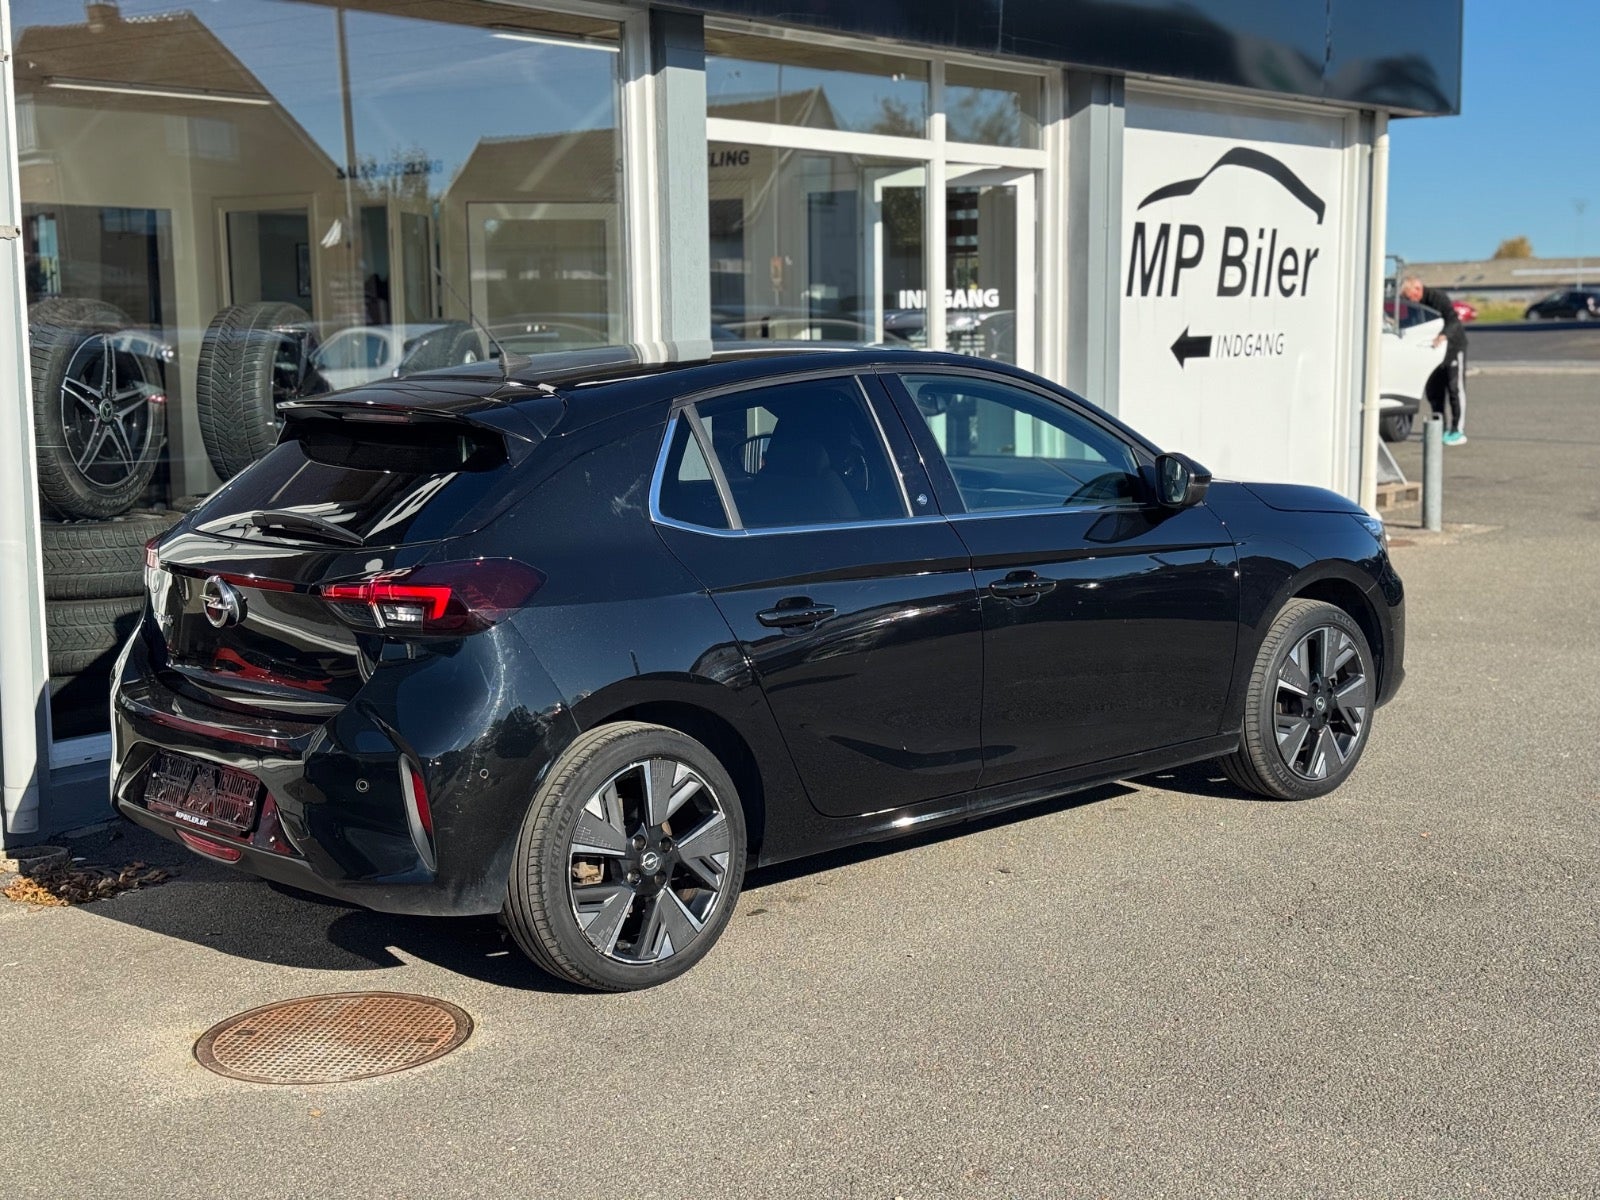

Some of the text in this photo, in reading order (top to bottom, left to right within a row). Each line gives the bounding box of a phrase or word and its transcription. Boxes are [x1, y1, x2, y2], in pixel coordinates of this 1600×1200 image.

[709, 149, 750, 168] LING
[1126, 222, 1319, 298] MP Biler
[1216, 333, 1284, 358] INDGANG
